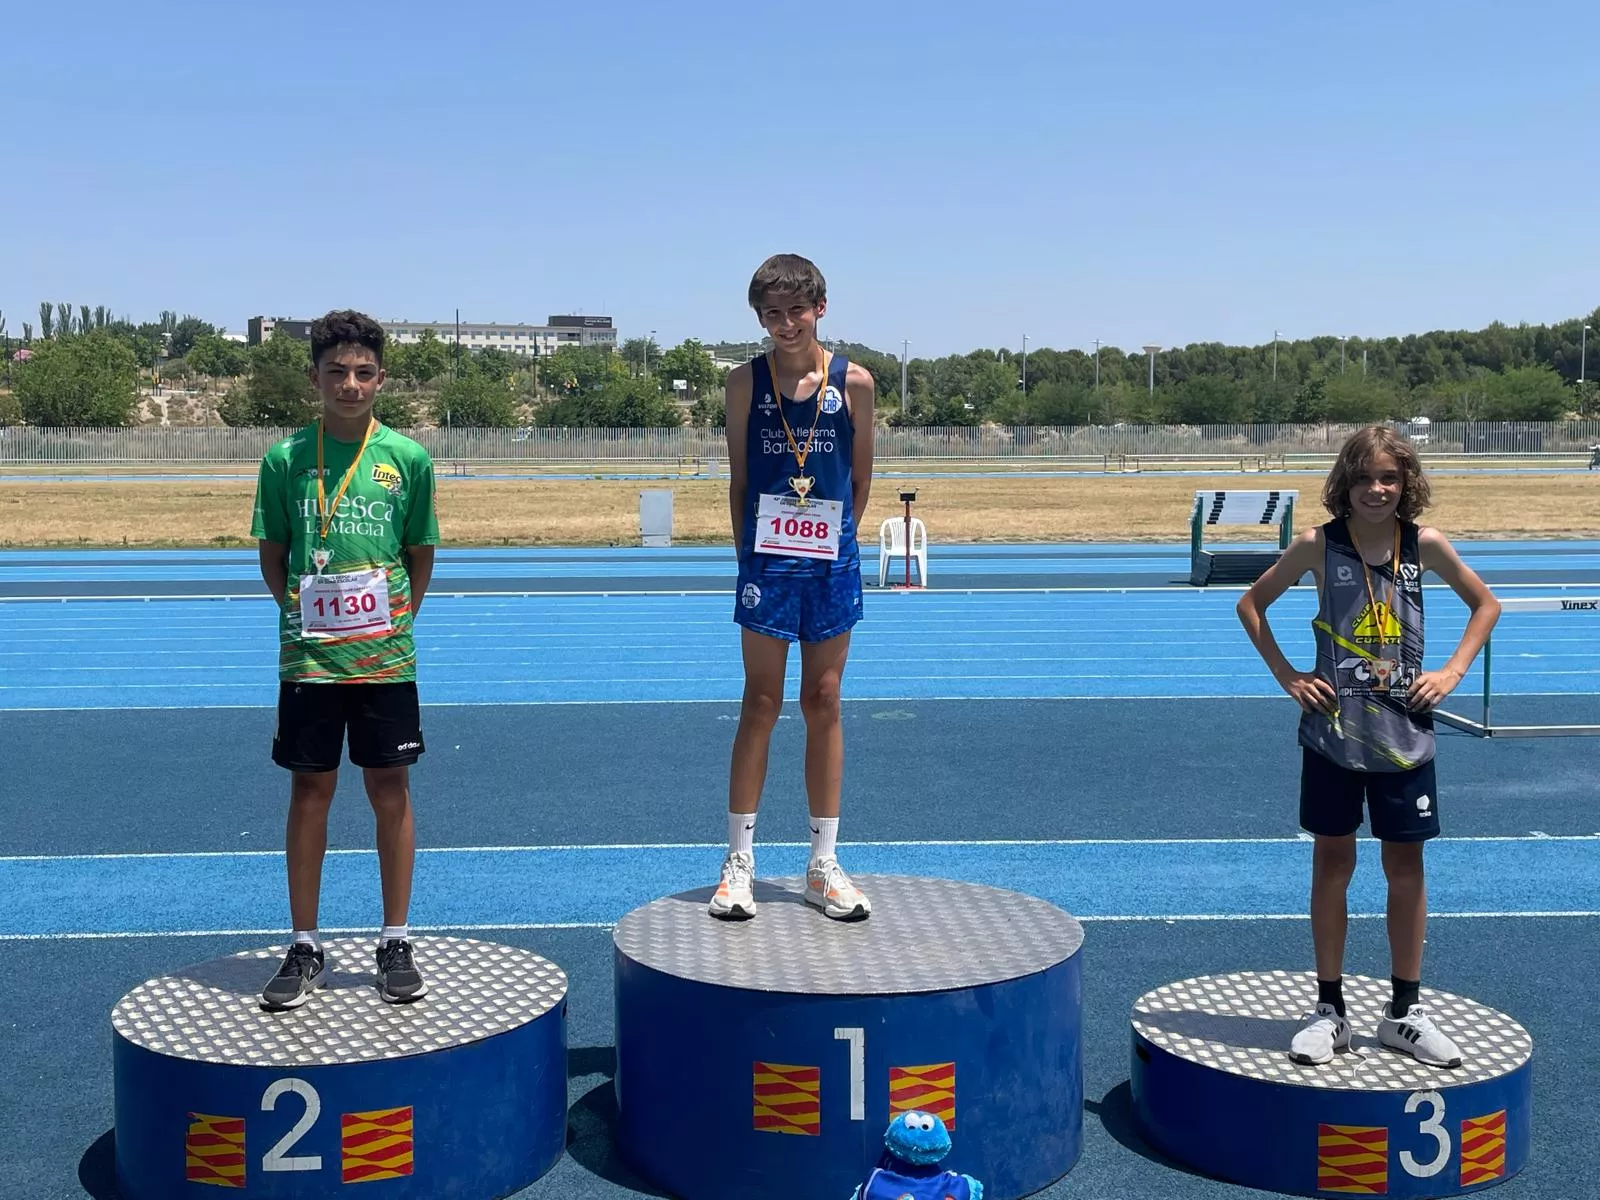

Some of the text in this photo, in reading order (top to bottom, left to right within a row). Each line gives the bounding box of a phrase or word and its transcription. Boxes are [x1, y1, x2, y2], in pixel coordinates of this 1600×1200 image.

[760, 429, 785, 438] Club
[763, 439, 834, 454] Barbastro
[771, 517, 829, 540] 1088
[313, 593, 376, 617] 1130
[1560, 600, 1598, 611] Vinex
[833, 1027, 865, 1121] 1
[261, 1077, 322, 1172] 2
[1399, 1092, 1452, 1179] 3
